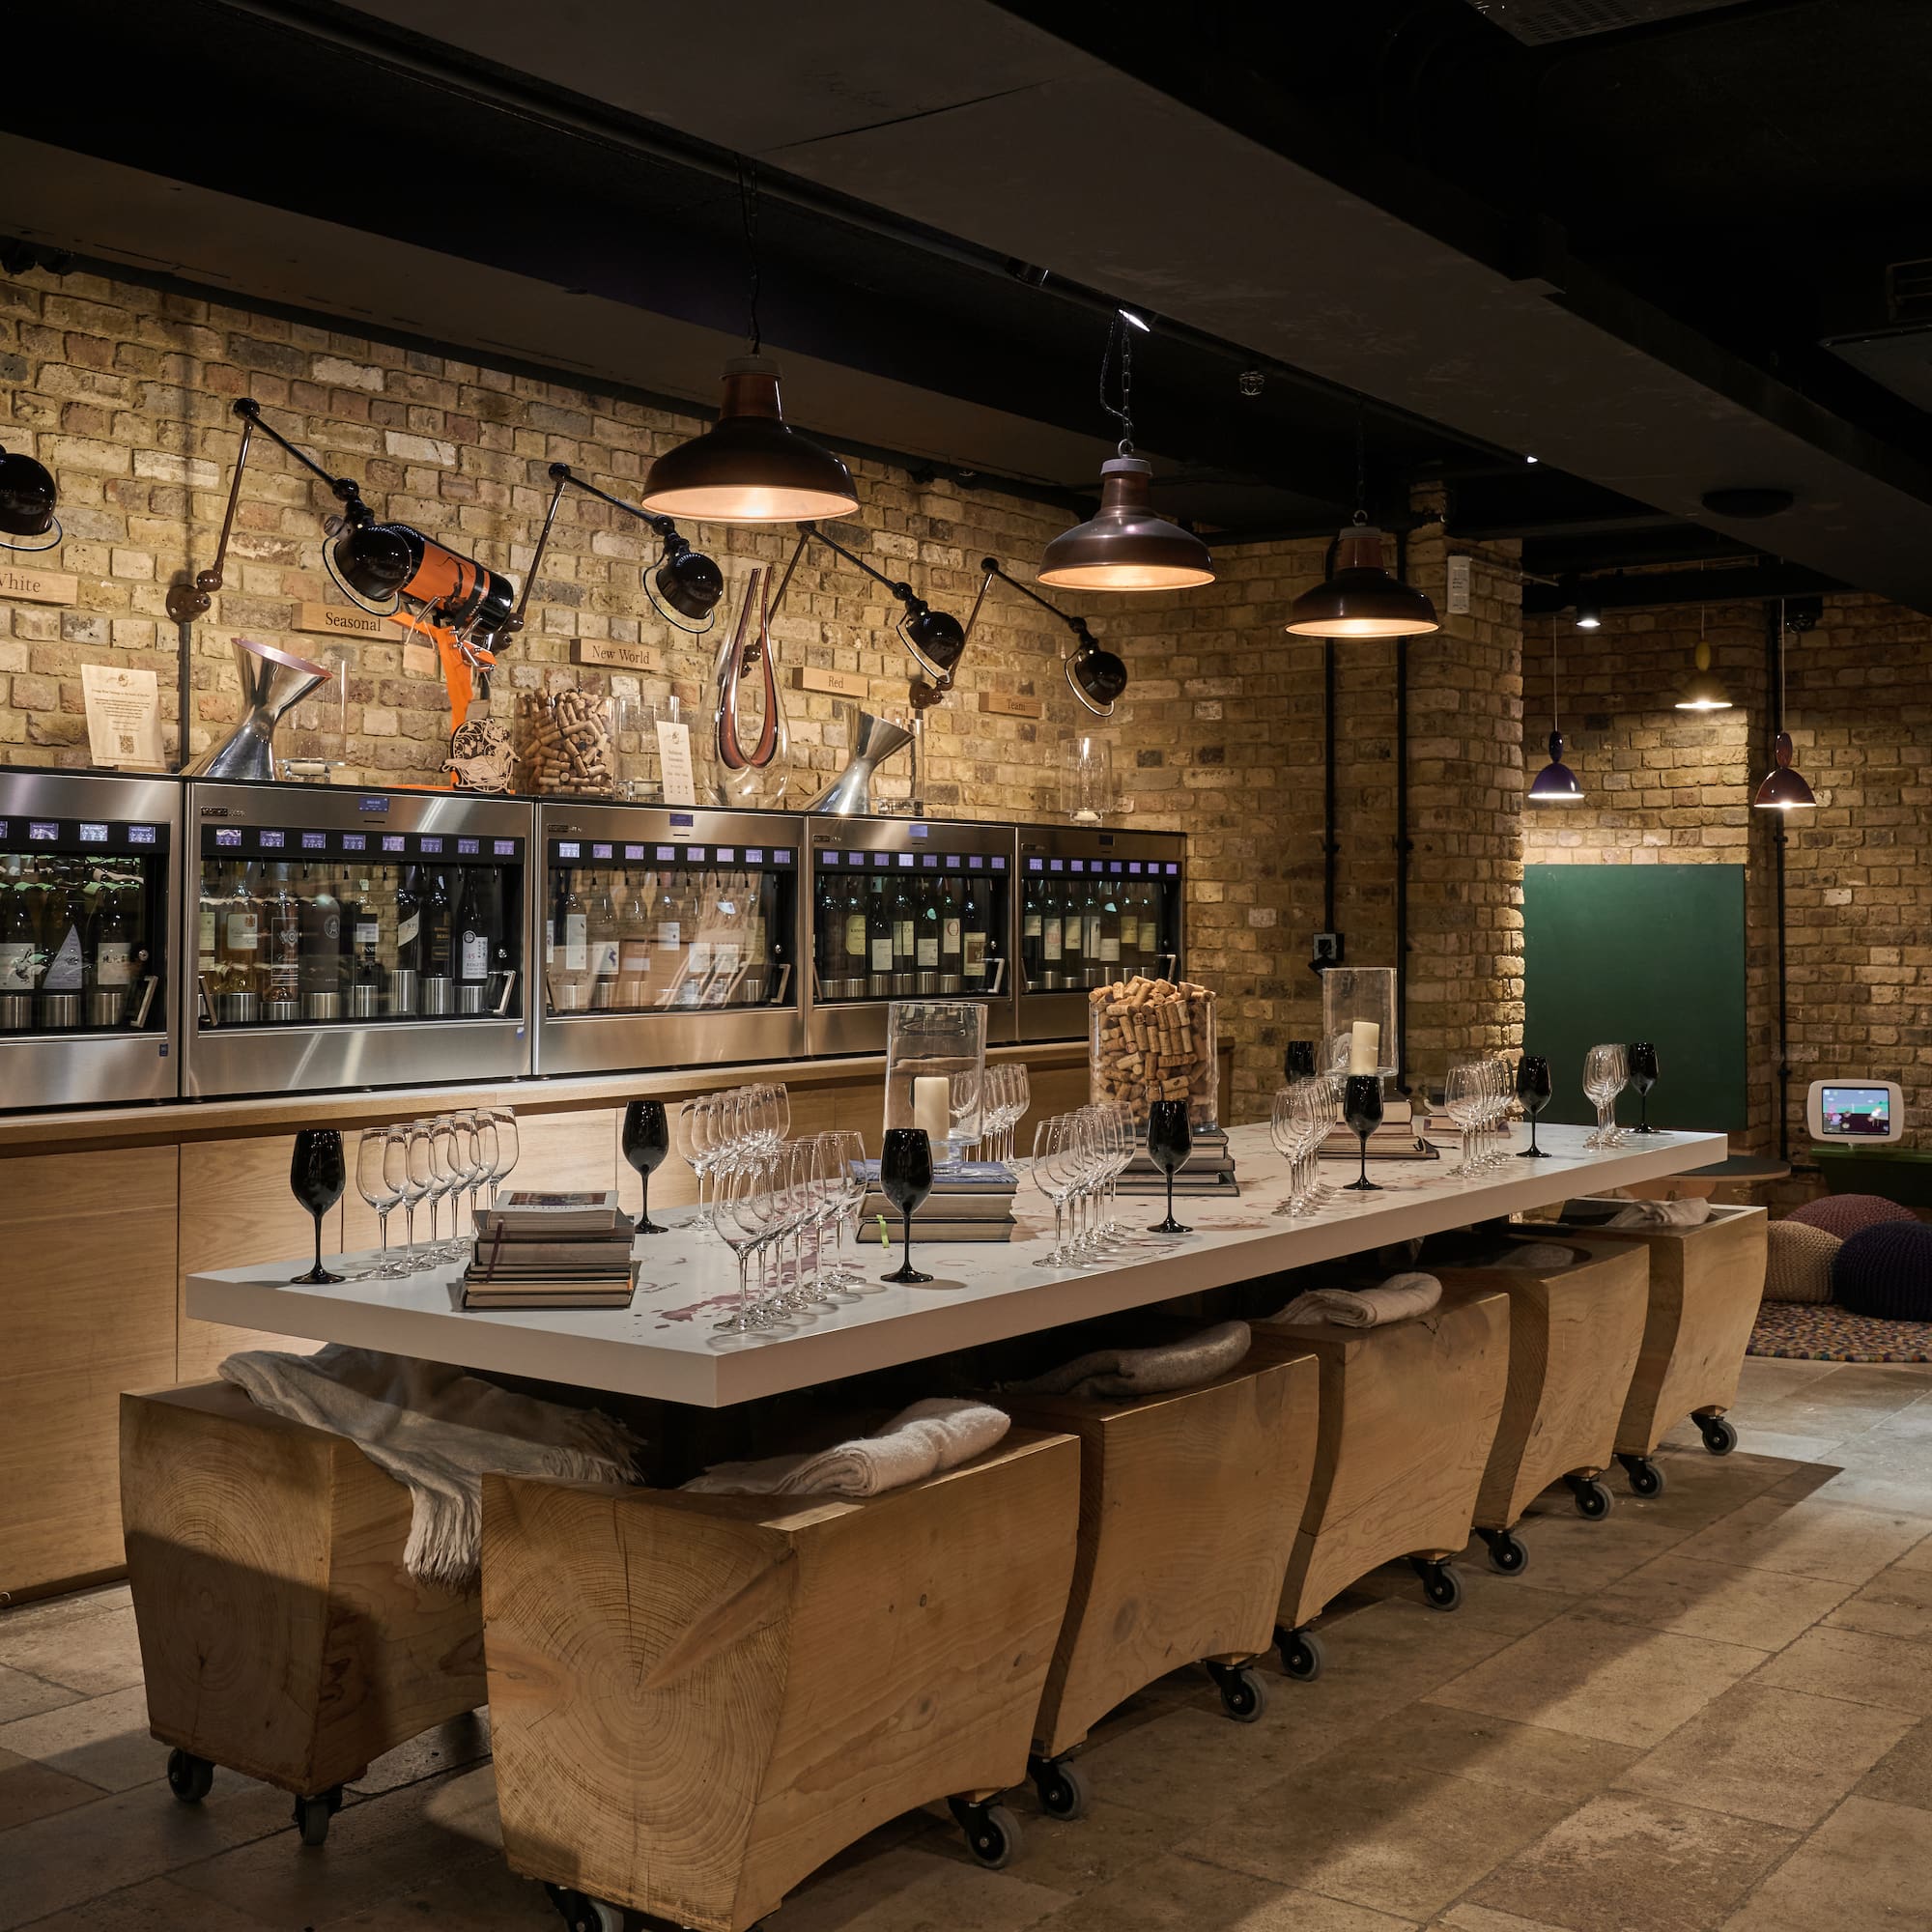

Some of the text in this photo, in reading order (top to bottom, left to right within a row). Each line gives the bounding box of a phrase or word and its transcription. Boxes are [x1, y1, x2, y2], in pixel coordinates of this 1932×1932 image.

[325, 611, 382, 632] Seasonal
[592, 645, 650, 665] New World
[828, 675, 844, 689] Red
